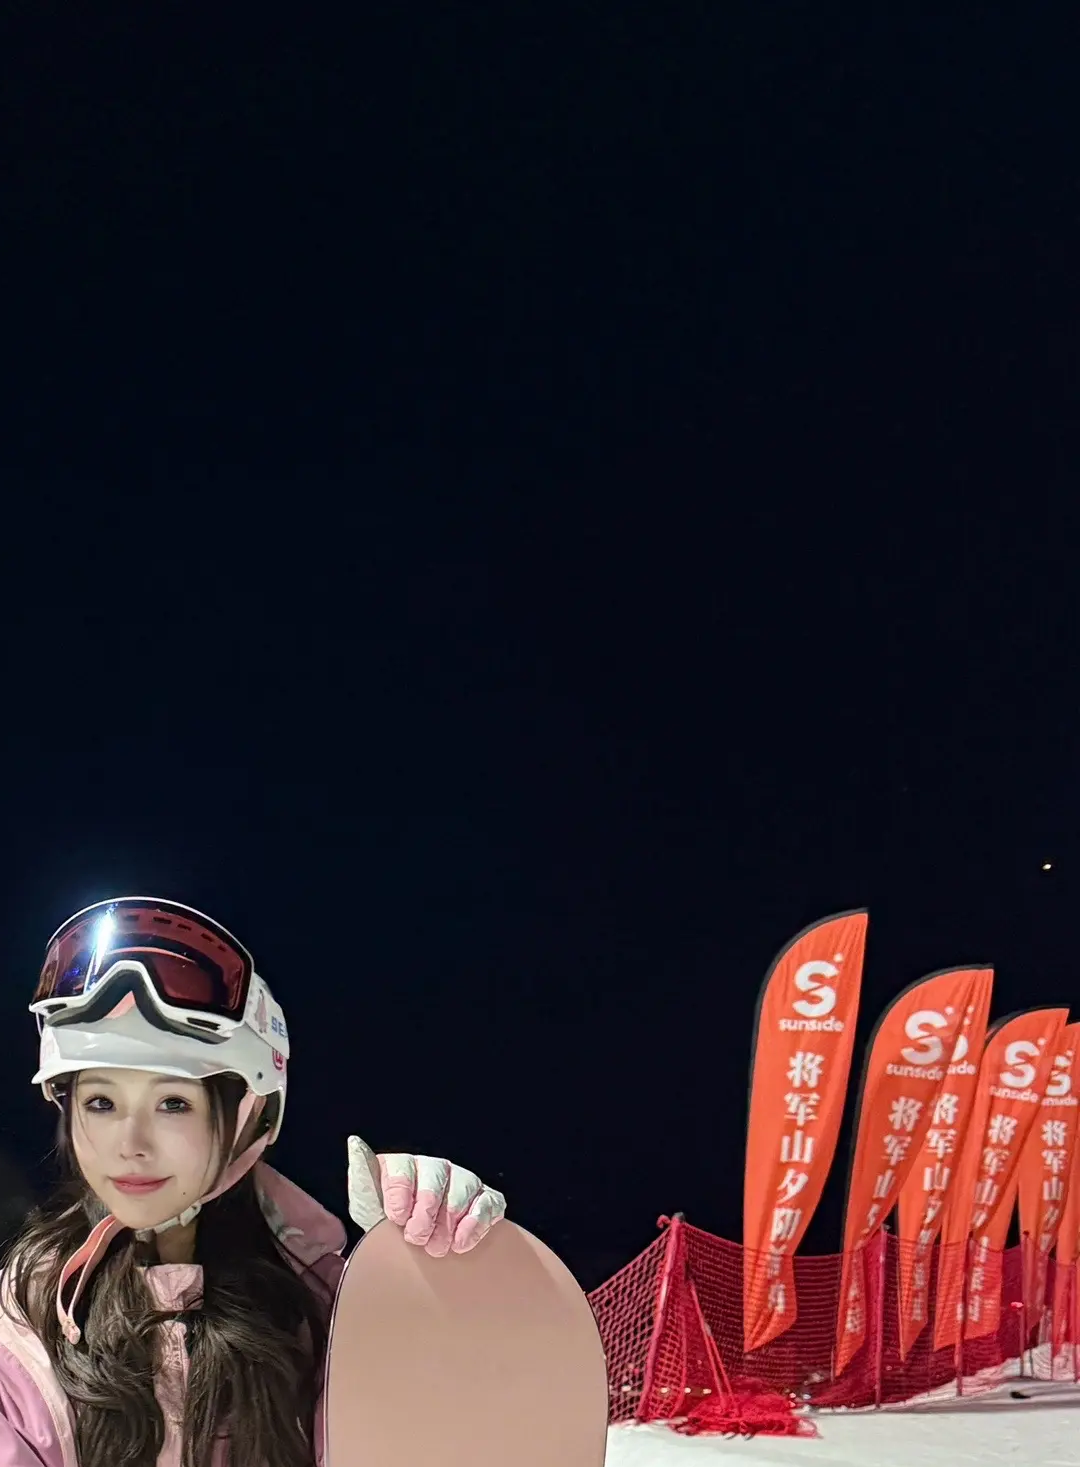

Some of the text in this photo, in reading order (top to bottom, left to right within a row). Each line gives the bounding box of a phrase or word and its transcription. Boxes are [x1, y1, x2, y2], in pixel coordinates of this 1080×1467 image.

[792, 960, 840, 1018] S
[778, 1016, 844, 1032] sunside
[900, 1010, 948, 1065] S
[999, 1041, 1040, 1088] S
